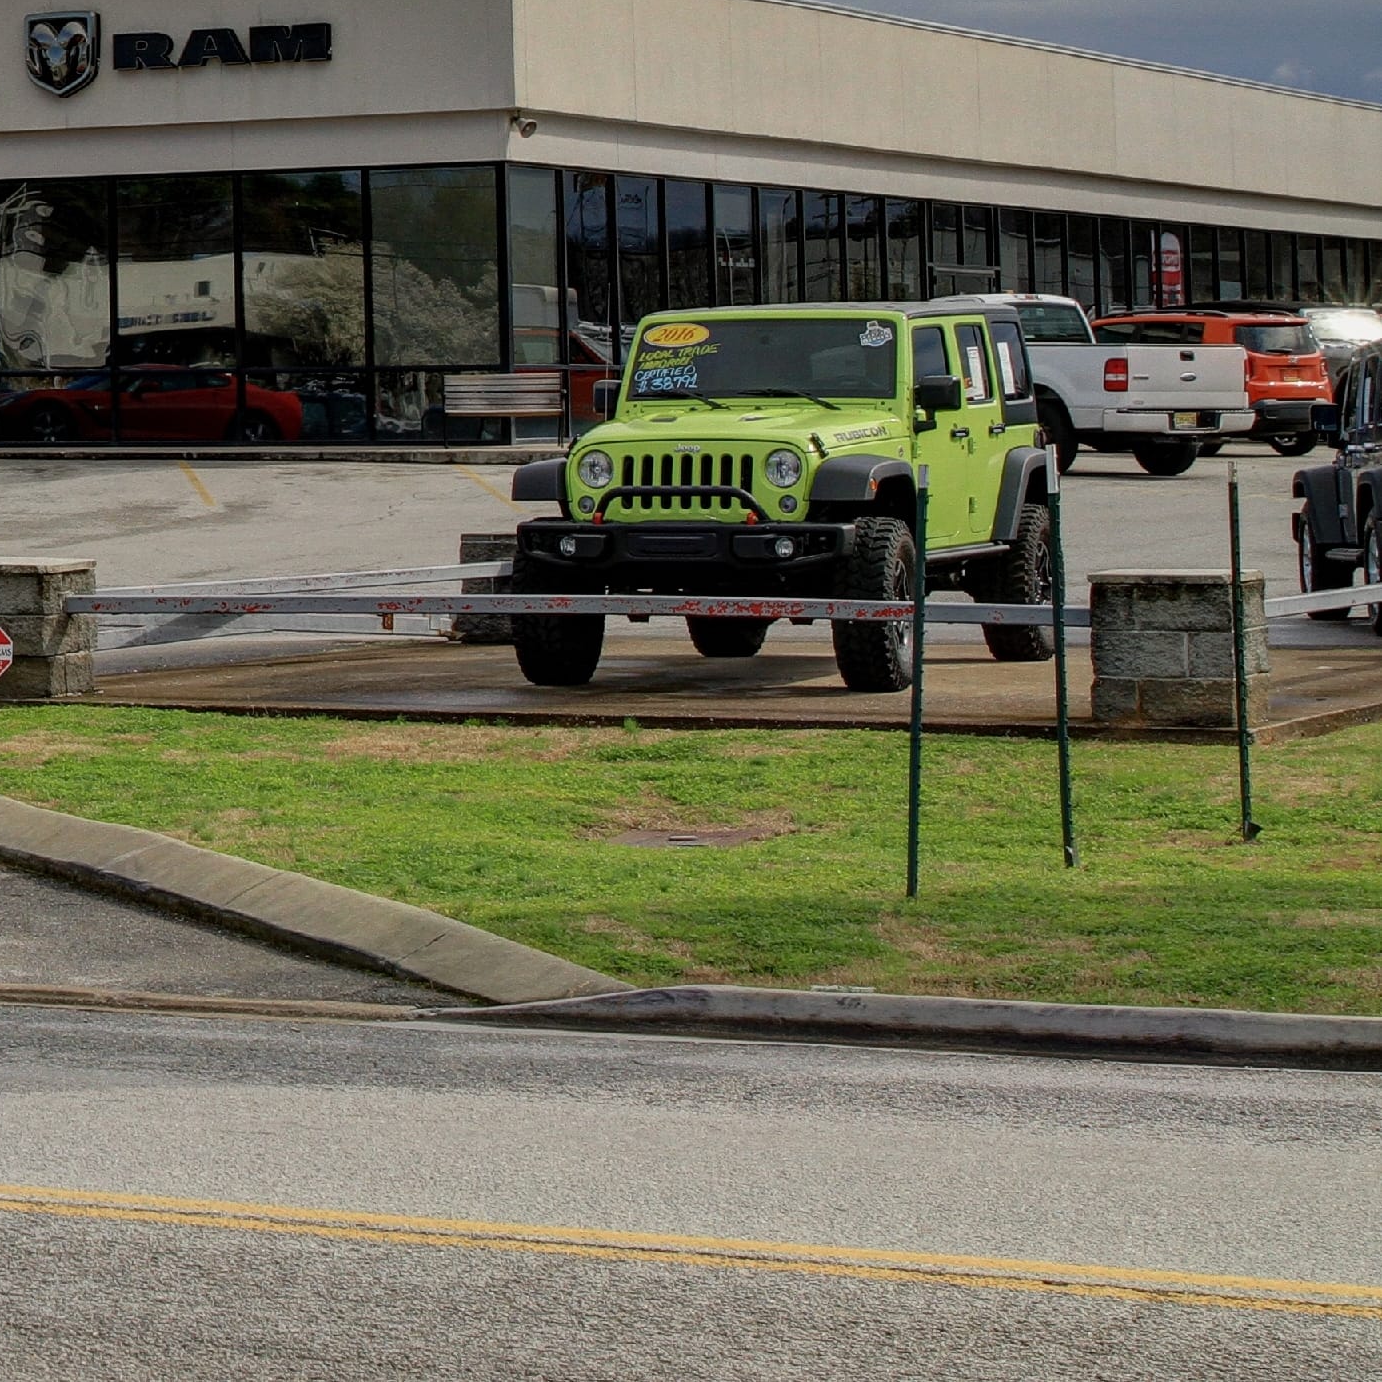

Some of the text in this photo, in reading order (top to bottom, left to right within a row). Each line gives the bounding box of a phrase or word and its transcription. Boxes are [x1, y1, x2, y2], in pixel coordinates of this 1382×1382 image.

[113, 23, 332, 70] RAM
[653, 328, 699, 342] 2016
[835, 425, 888, 443] RUBICON
[674, 442, 701, 454] Jeep
